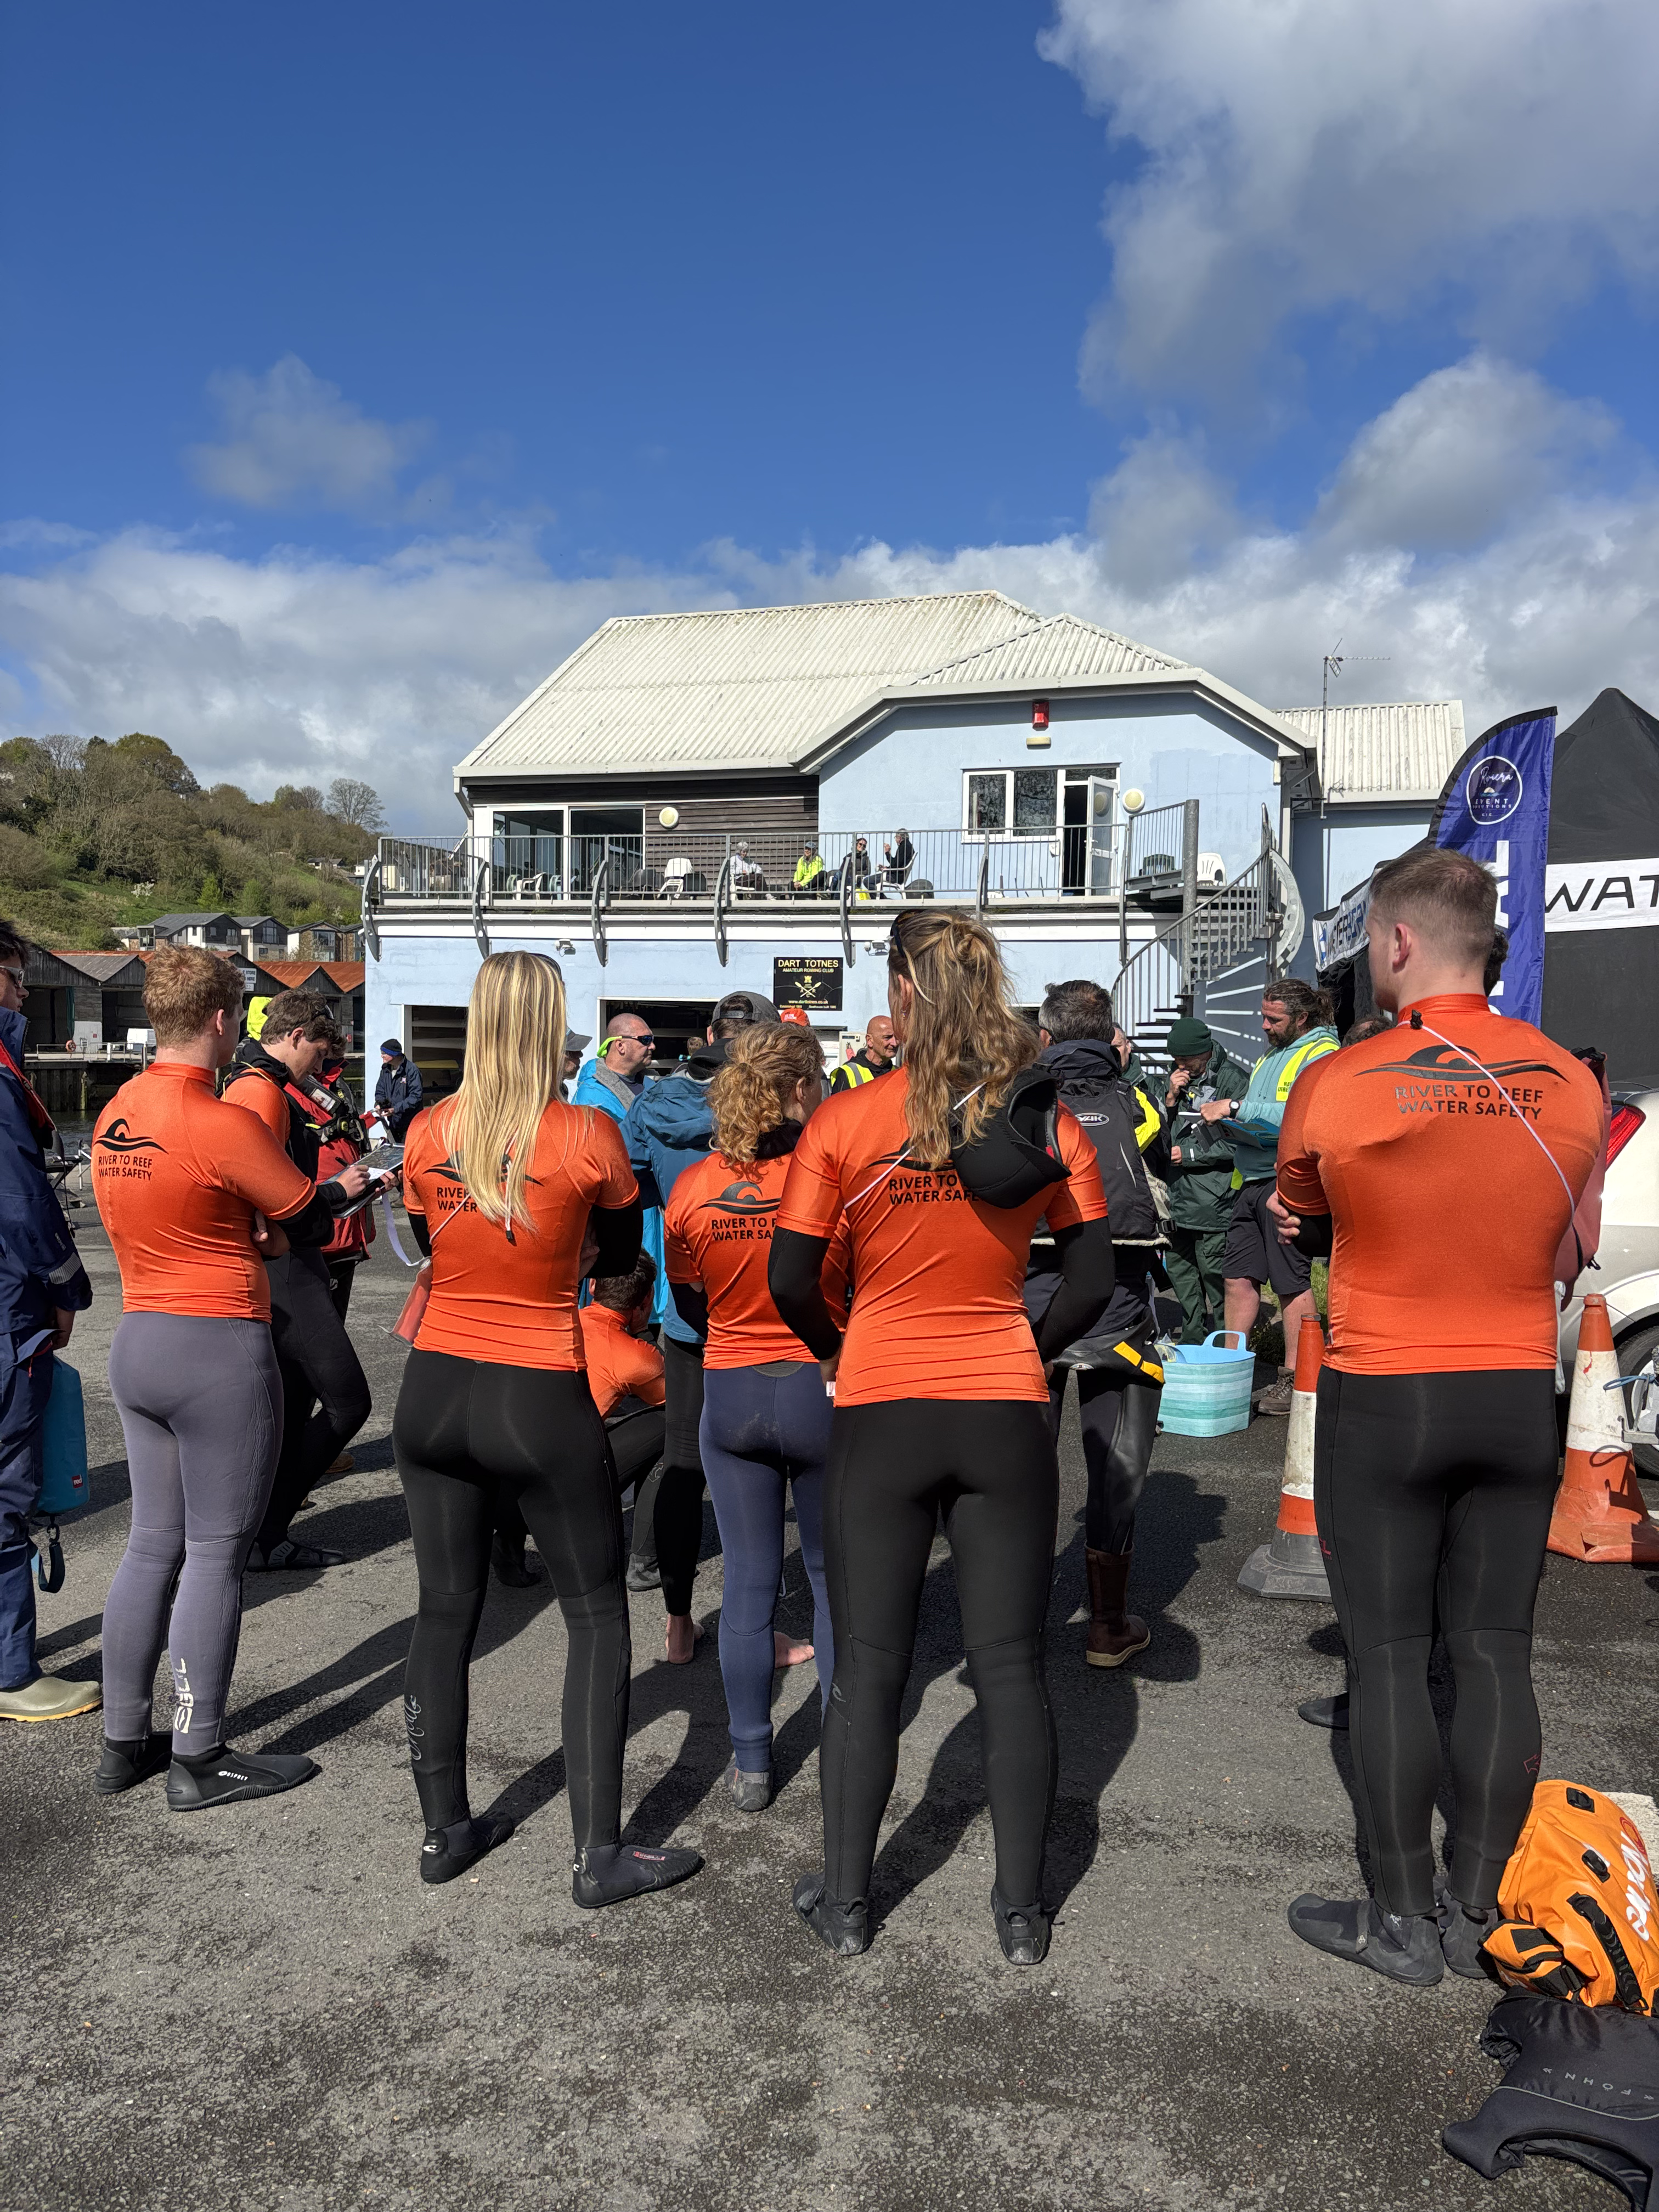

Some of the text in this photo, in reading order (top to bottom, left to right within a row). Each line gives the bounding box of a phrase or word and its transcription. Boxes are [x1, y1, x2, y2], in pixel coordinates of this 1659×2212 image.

[805, 960, 839, 968] TOTNES
[1395, 1085, 1458, 1099] RIVER
[1464, 1085, 1491, 1098] TO
[1397, 1100, 1542, 1120] WATER SAFETY
[99, 1155, 152, 1168] RIVER TO REEF
[99, 1167, 152, 1181] WATER SAFETY
[889, 1175, 957, 1191] RIVER TO
[889, 1189, 979, 1205] WATER SAFE
[712, 1218, 747, 1229] RIVER
[750, 1217, 767, 1227] TO
[712, 1230, 754, 1241] WATER
